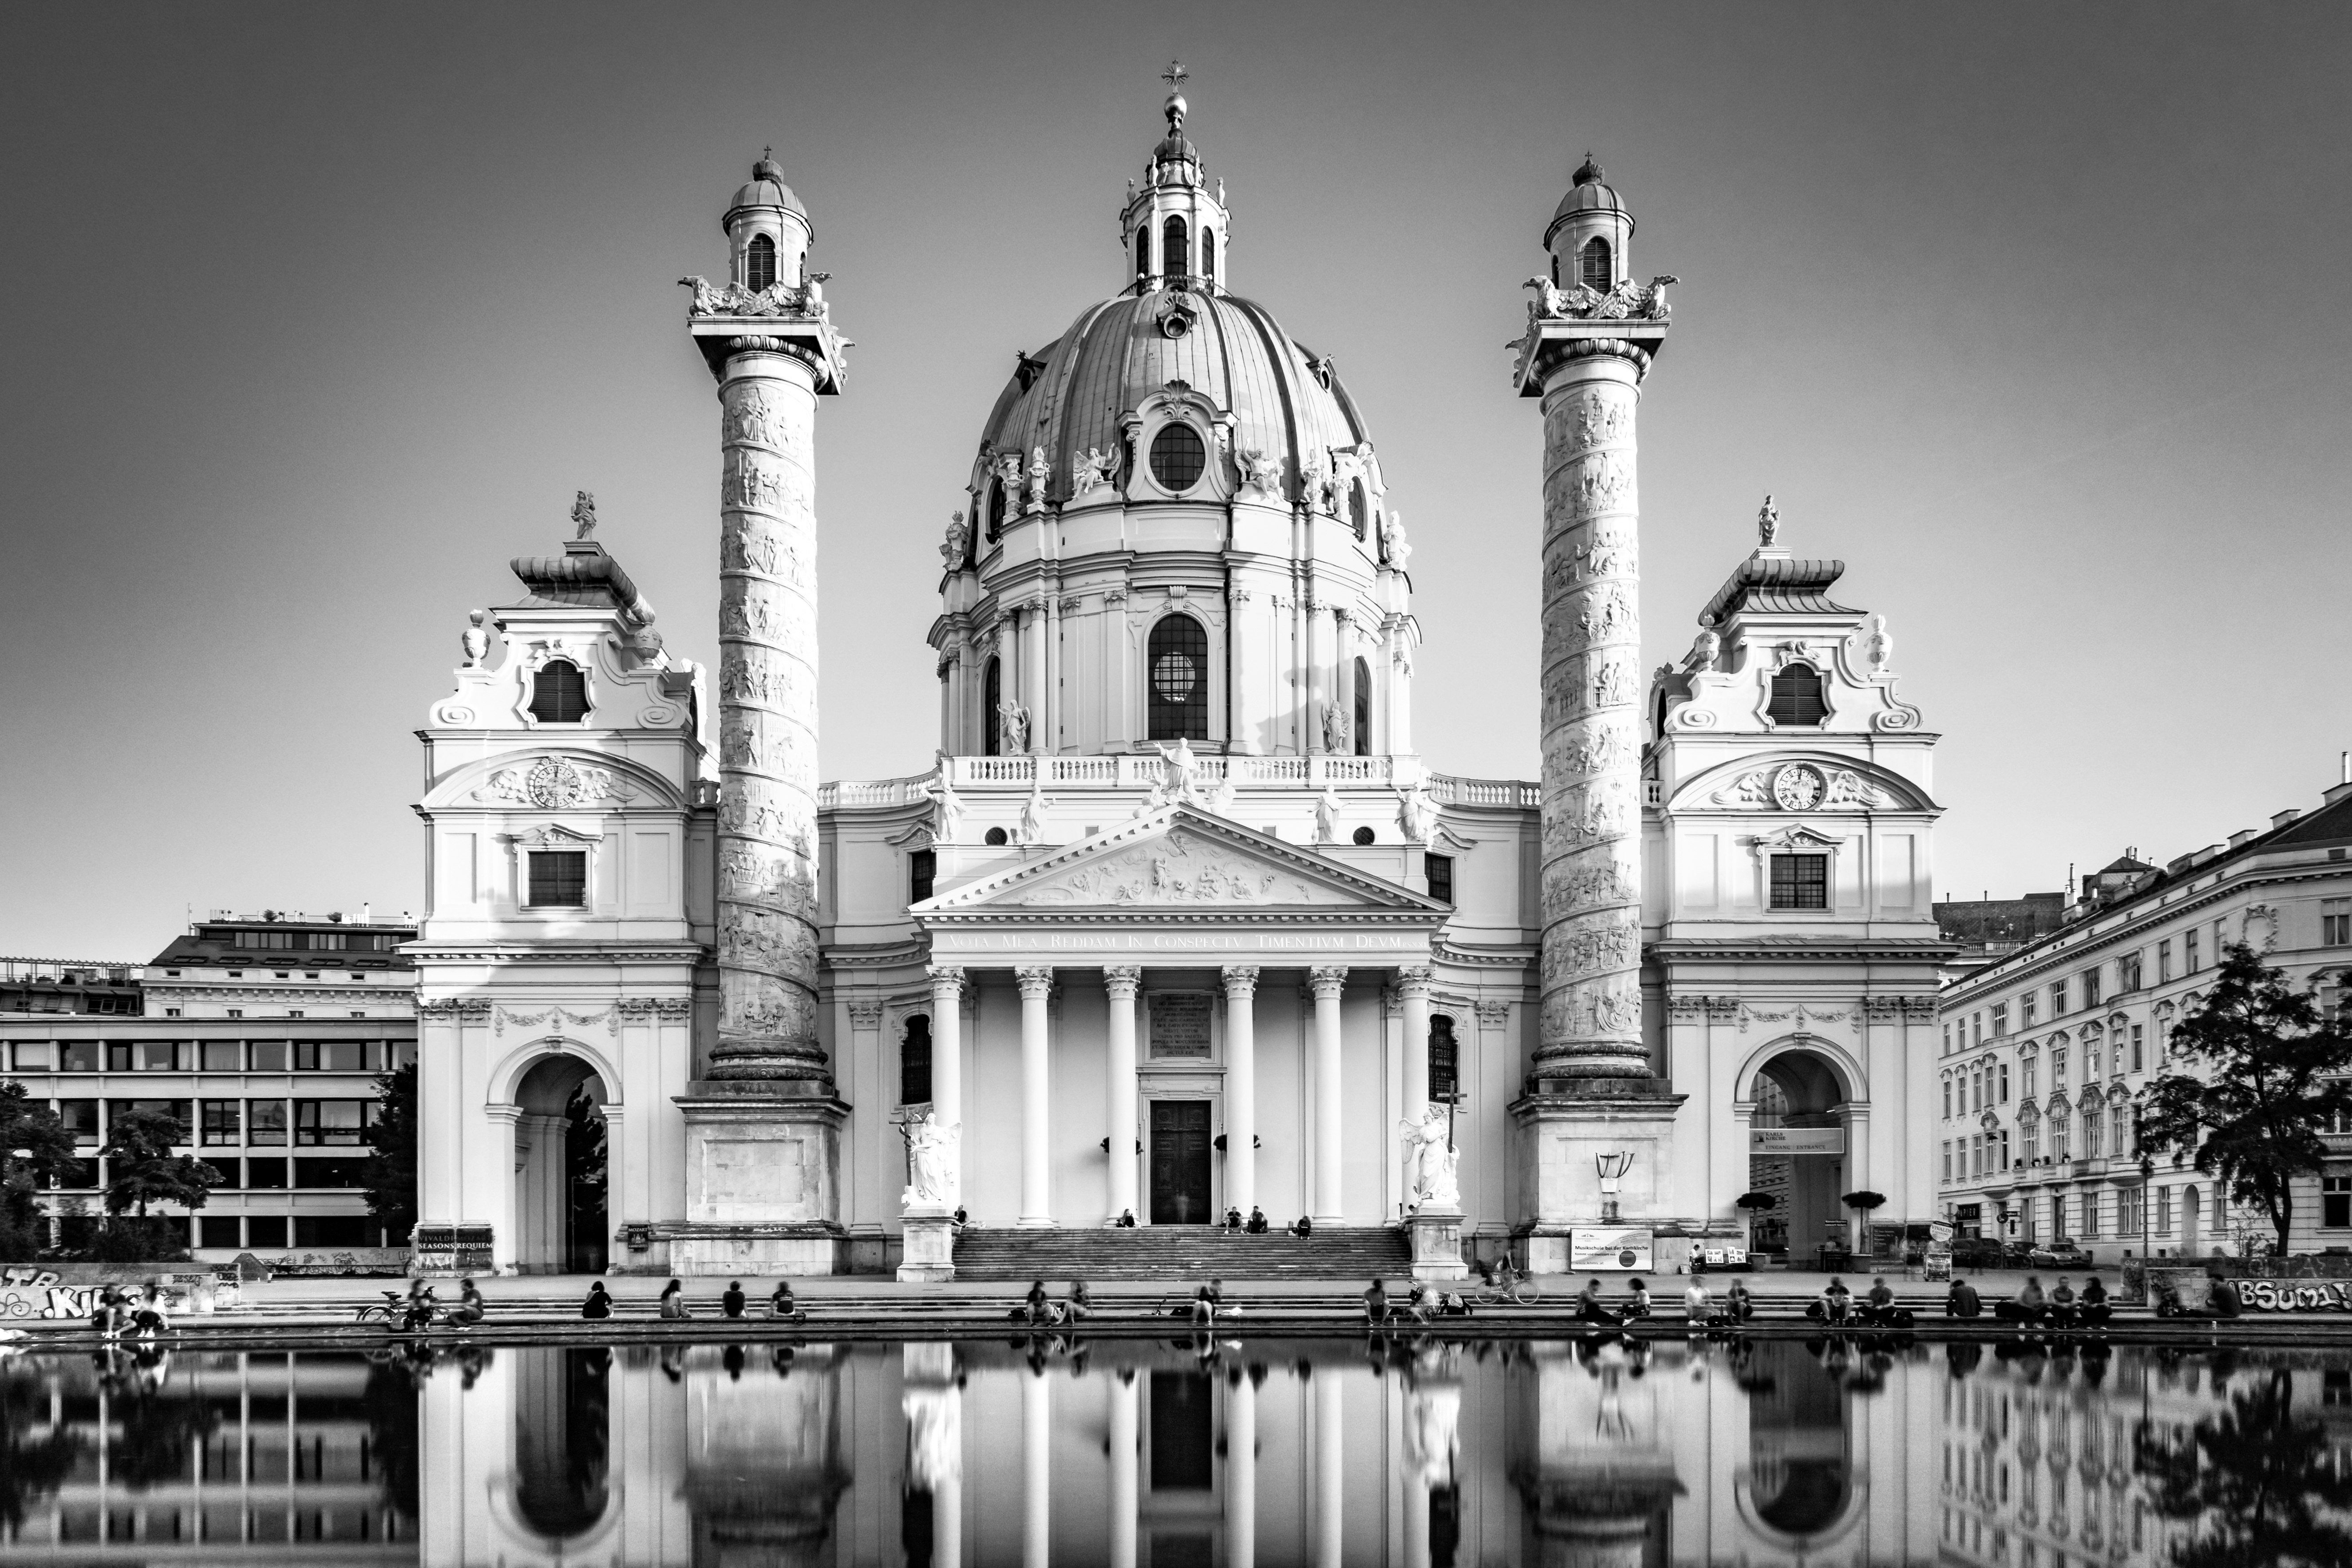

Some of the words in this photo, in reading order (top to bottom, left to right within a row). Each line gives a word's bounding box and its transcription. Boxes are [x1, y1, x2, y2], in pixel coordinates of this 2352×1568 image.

[948, 935, 989, 948] VOTA
[1002, 935, 1038, 948] MEA
[1051, 935, 1115, 948] REDDAM
[1128, 935, 1142, 948] IN
[1154, 935, 1243, 948] CONSPECTV
[1255, 935, 1344, 948] TIMENTIVM
